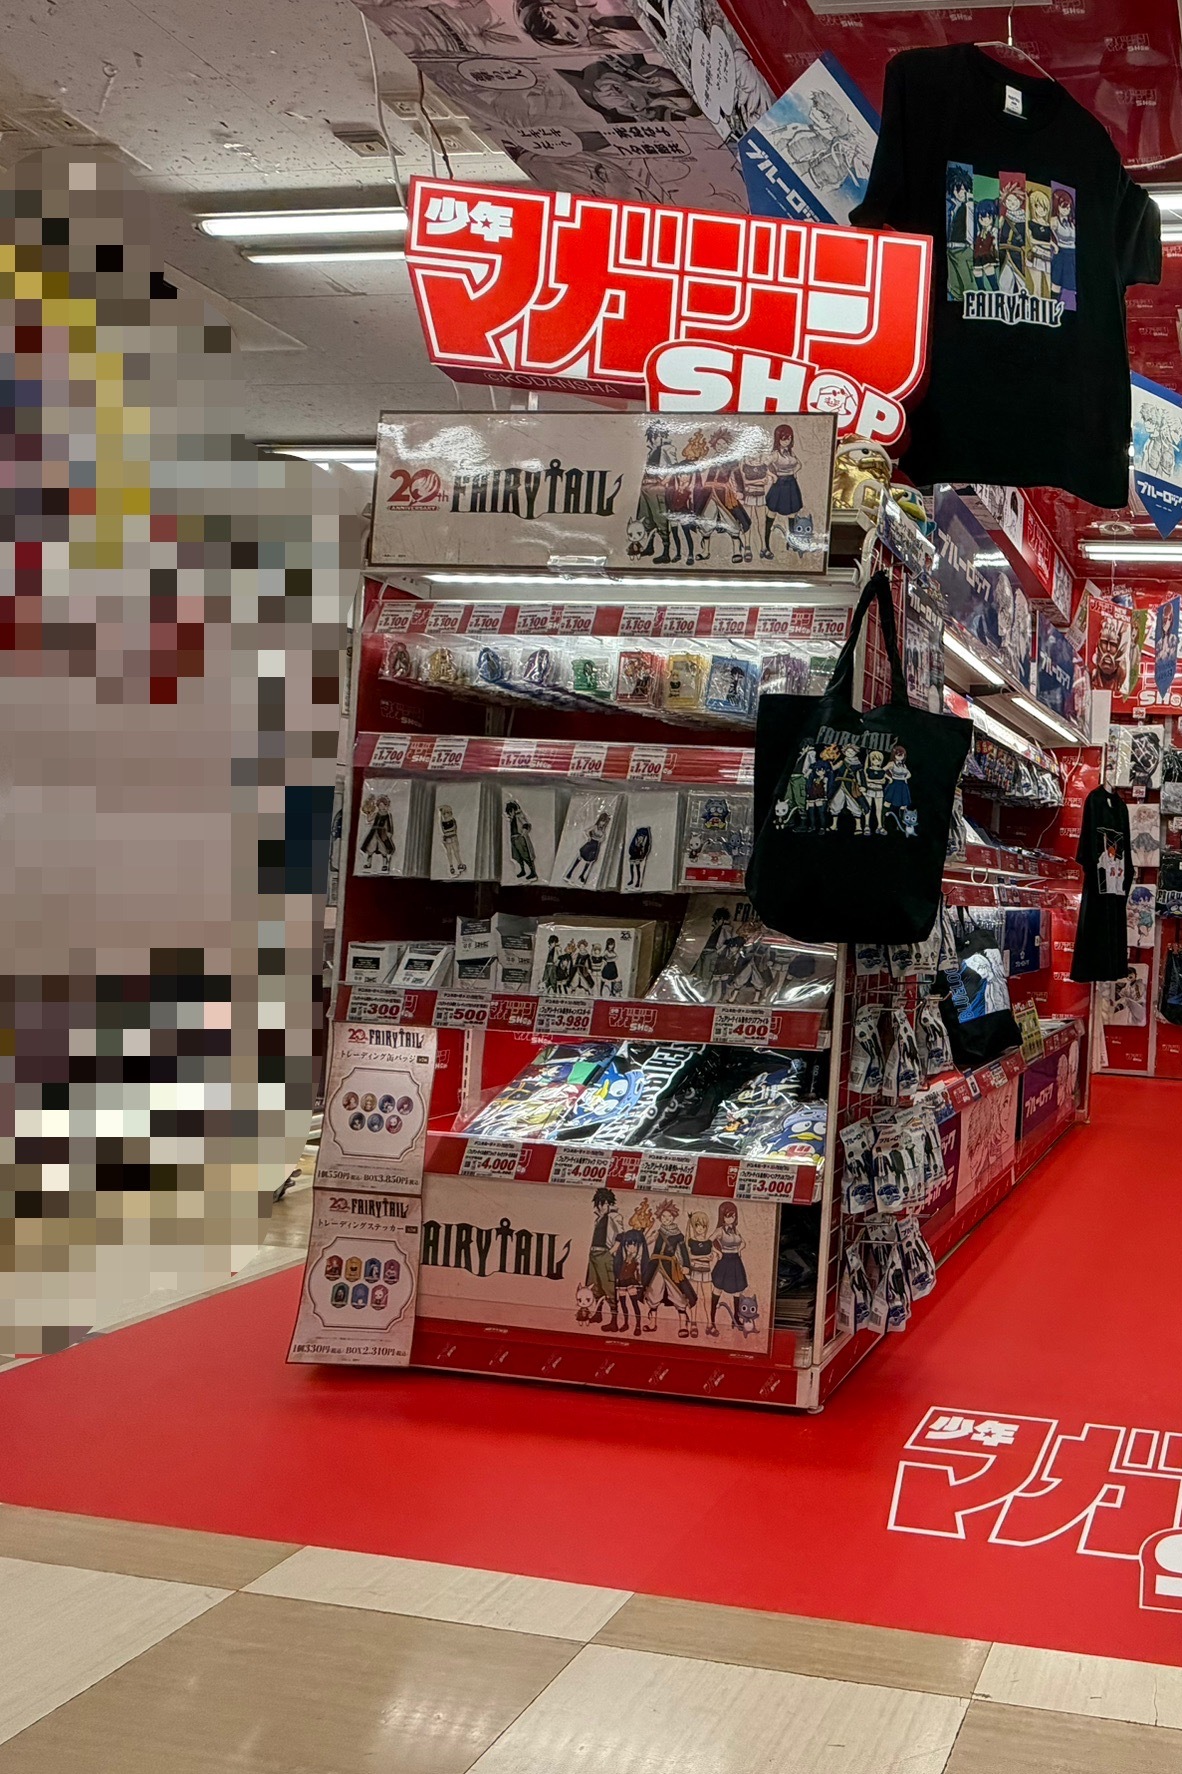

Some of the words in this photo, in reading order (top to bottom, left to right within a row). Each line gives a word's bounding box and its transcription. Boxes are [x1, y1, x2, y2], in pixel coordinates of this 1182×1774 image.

[425, 196, 514, 243] 少年
[408, 177, 934, 400] マガジン
[655, 345, 902, 438] SHOP
[451, 468, 541, 519] FAIRY
[545, 459, 625, 517] TAIL
[938, 529, 992, 602] ブルーロック
[367, 1003, 400, 1016] 300
[454, 1009, 487, 1021] 500
[555, 1014, 590, 1028] 3,980
[732, 1023, 768, 1036] 400
[369, 1029, 397, 1048] FAIRY
[398, 1028, 424, 1048] TAIL
[340, 1050, 416, 1064] トレーディング缶バッジ
[481, 1157, 517, 1171] 4,000
[571, 1164, 607, 1178] 4,000
[658, 1171, 693, 1186] 3,500
[756, 1179, 793, 1193] 3,000
[351, 1198, 381, 1219] FAIRY
[382, 1197, 409, 1219] TAIL
[318, 1218, 405, 1232] トレーディングステッカー
[422, 1220, 500, 1278] AIRY
[497, 1217, 572, 1281] TAIL
[924, 1414, 1021, 1448] 少年
